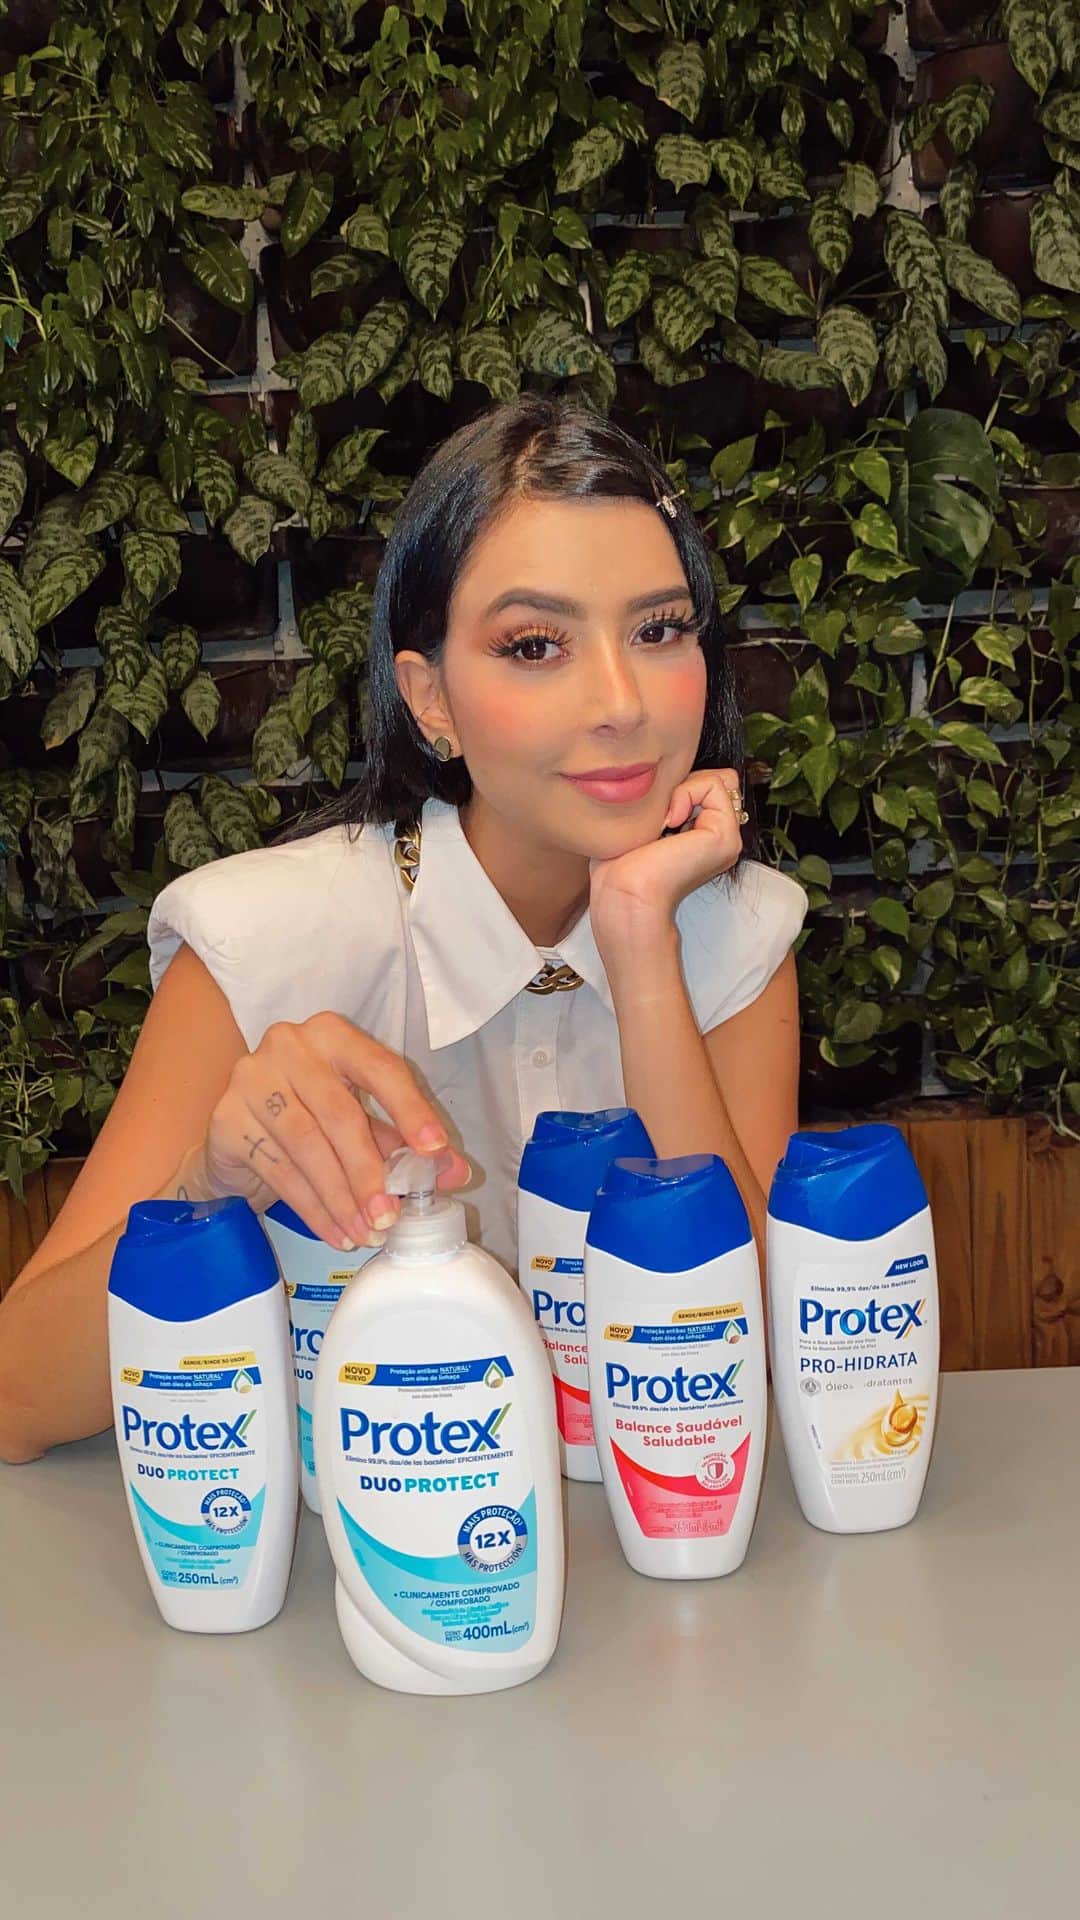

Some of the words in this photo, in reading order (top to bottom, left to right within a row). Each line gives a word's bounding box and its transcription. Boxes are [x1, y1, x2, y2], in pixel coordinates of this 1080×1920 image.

[532, 1289, 587, 1327] Pro
[799, 1298, 926, 1340] Protex
[344, 1365, 370, 1376] NOVO
[800, 1352, 918, 1373] PRO-HIDRATA
[389, 1368, 416, 1376] Proteção
[605, 1359, 745, 1404] Protex
[121, 1405, 257, 1451] Protex
[340, 1403, 512, 1456] Protex
[616, 1419, 672, 1433] Balance
[676, 1415, 742, 1433] Saudável
[643, 1434, 716, 1447] Saludable
[458, 1450, 513, 1464] EFICIENTEMENTE
[138, 1463, 165, 1479] DUO
[168, 1468, 239, 1481] PROTECT
[360, 1475, 401, 1492] DUO
[405, 1471, 499, 1493] PROTECT
[213, 1506, 239, 1517] 12X
[463, 1513, 481, 1533] MAIS
[475, 1530, 511, 1549] 12X
[178, 1572, 218, 1585] 250mL
[399, 1590, 460, 1599] CLINICAMENTE
[461, 1582, 520, 1597] COMPROVADO
[435, 1595, 490, 1607] COMPROBADO
[463, 1620, 512, 1640] 400mL
